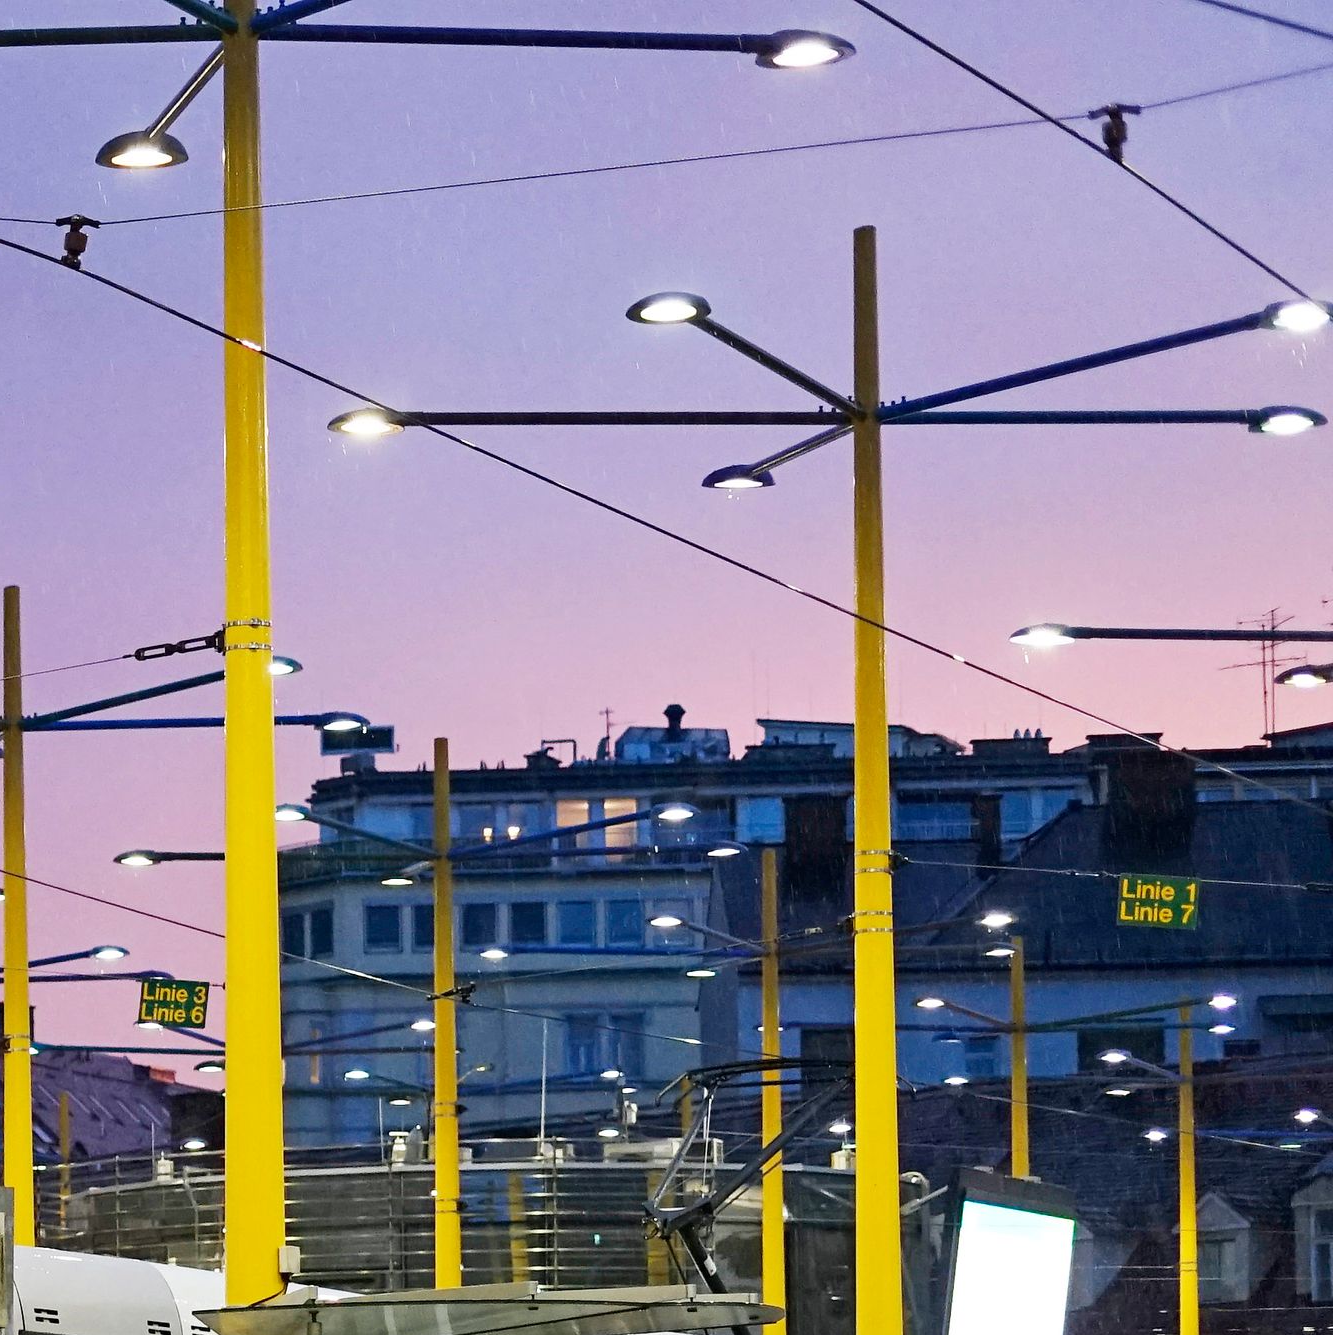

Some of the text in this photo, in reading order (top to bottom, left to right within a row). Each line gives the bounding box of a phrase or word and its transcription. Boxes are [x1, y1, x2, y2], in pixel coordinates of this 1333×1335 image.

[1121, 879, 1196, 903] Linie 1
[1120, 901, 1195, 924] Linie 7
[142, 982, 207, 1004] Linie 3
[141, 1002, 205, 1024] Linie 6
